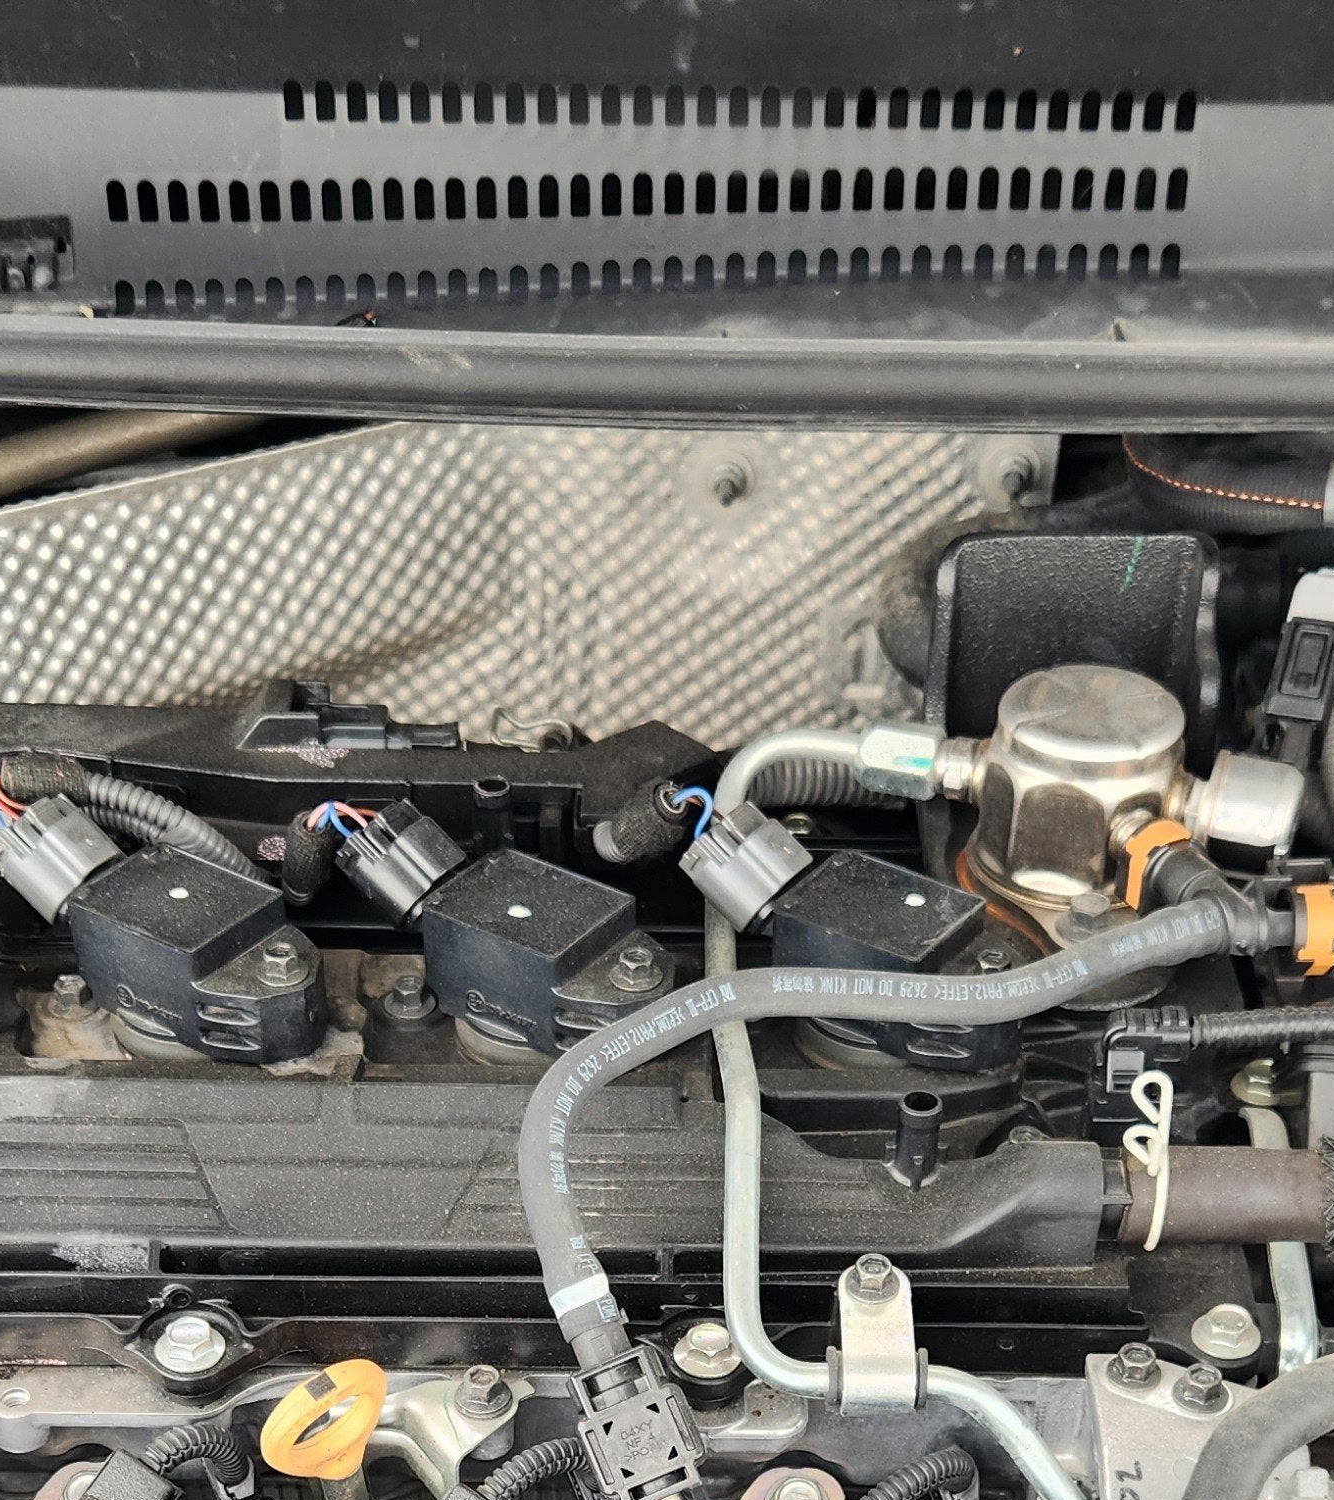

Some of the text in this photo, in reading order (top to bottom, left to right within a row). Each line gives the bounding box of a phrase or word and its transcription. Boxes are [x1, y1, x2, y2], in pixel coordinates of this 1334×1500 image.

[818, 974, 847, 994] KINK
[852, 976, 873, 995] NOT
[878, 979, 893, 996] DO
[562, 1074, 585, 1096] DO
[550, 1090, 576, 1116] NOT
[545, 1114, 569, 1147] KINK
